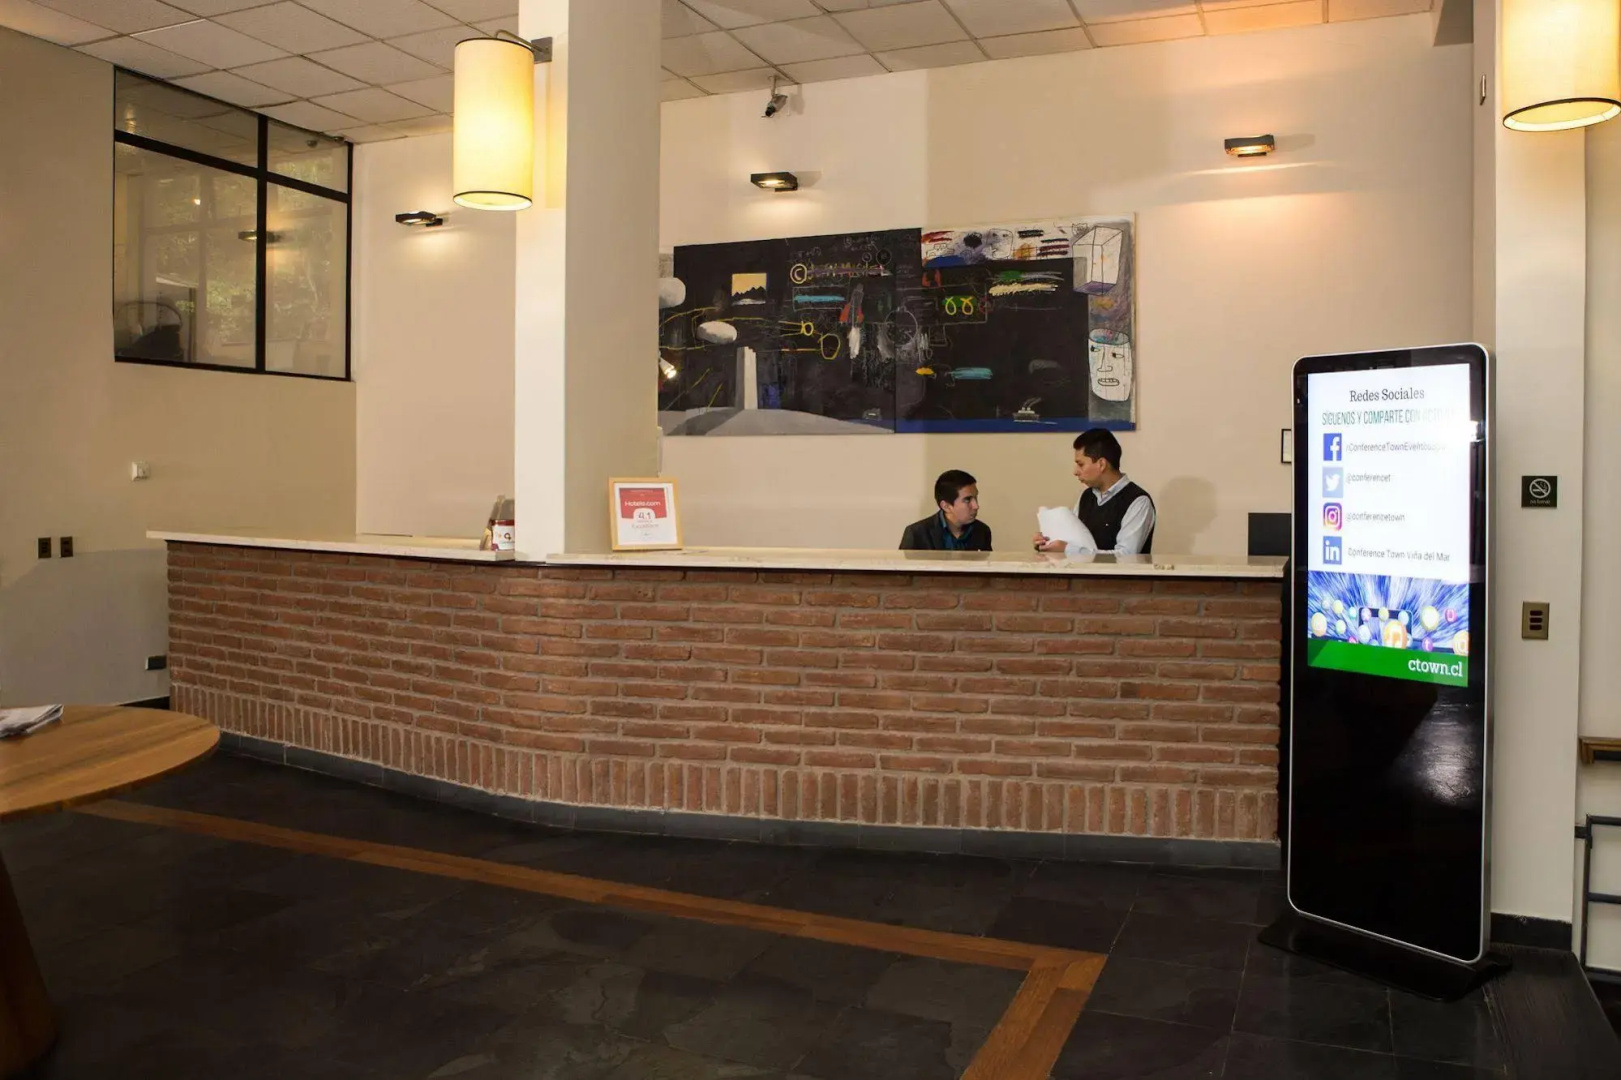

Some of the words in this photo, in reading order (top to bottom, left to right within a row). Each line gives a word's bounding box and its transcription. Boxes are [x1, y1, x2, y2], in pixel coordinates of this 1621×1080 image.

[1349, 389, 1380, 402] Redes
[1381, 387, 1425, 401] Sociales
[1322, 410, 1355, 426] SÍGUENOS
[1357, 410, 1362, 425] Y
[1363, 409, 1404, 425] COMPARTE
[1405, 408, 1421, 424] CON
[1347, 547, 1385, 558] Conference
[1387, 549, 1405, 559] Town
[1424, 551, 1435, 561] del
[1436, 552, 1451, 562] Mar
[1408, 658, 1463, 677] ctown.cl
